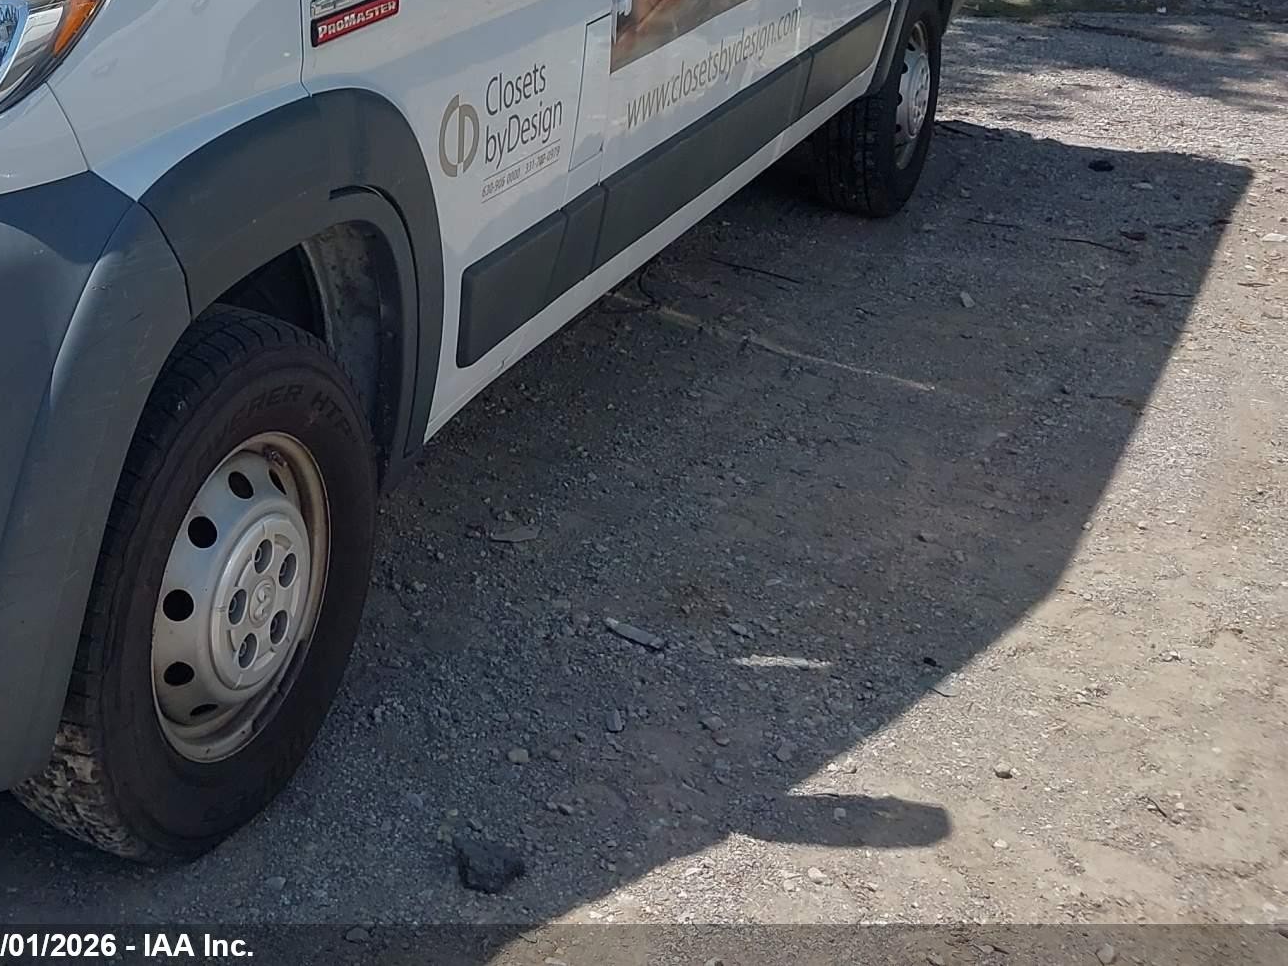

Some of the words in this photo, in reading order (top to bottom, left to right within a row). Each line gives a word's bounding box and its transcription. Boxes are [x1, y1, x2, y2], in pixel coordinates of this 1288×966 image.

[485, 62, 547, 117] Closets
[626, 6, 802, 130] www.closetsbydesign.com
[484, 100, 563, 171] byDesign
